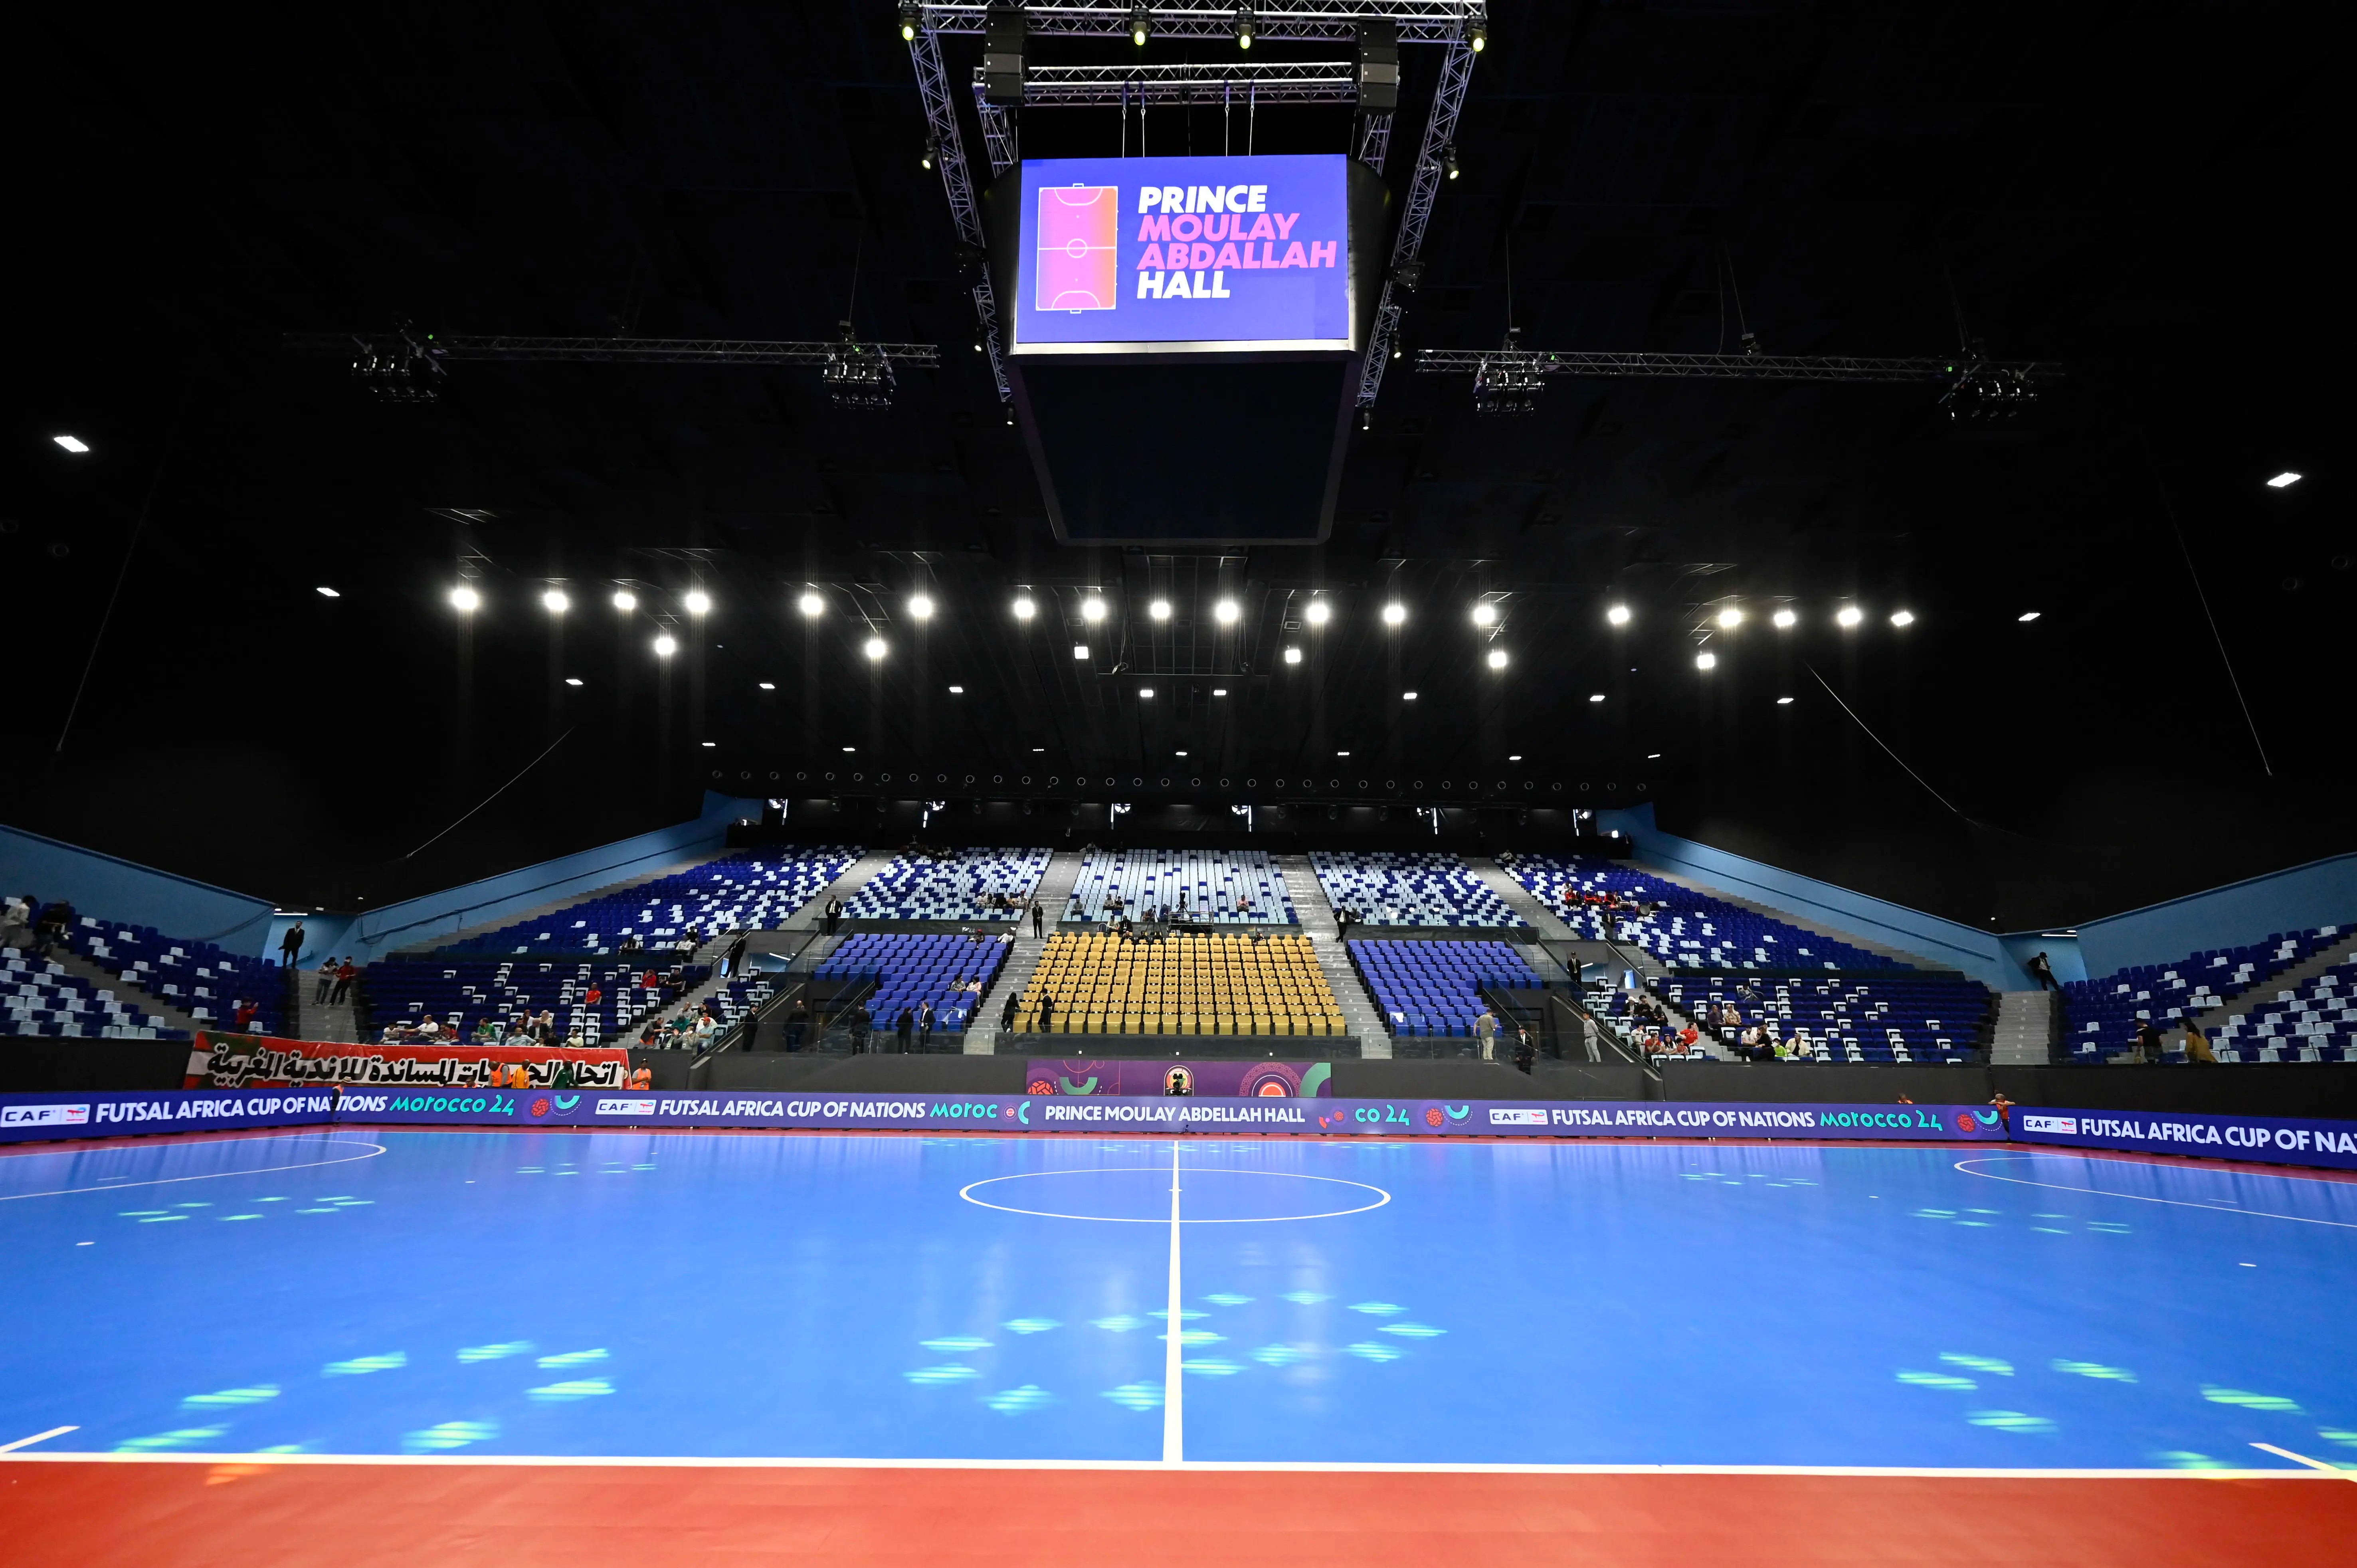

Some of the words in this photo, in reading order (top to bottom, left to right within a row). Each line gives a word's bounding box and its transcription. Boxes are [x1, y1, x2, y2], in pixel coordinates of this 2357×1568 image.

[1138, 185, 1268, 214] PRINCE
[1138, 213, 1300, 242] MOULAY
[1136, 240, 1337, 270] ABDALLAH
[1137, 270, 1231, 299] HALL
[570, 1062, 618, 1086] اتحا
[5, 1111, 51, 1122] CAF
[96, 1101, 173, 1123] FUTSAL
[176, 1099, 244, 1119] AFRICA
[247, 1097, 281, 1115] CUP
[283, 1097, 306, 1114] OF
[307, 1095, 388, 1112] NATIONS
[489, 1094, 515, 1116] 24
[659, 1099, 720, 1115] FUTSAL
[721, 1100, 784, 1117] AFRICA
[787, 1101, 821, 1117] CUP
[823, 1101, 849, 1117] OF
[849, 1102, 926, 1118] NATIONS
[1045, 1105, 1102, 1121] PRINCE
[1104, 1106, 1177, 1121] MOULAY
[1178, 1107, 1262, 1122] ABDELLAH
[1264, 1107, 1306, 1123] HALL
[1385, 1104, 1410, 1126] 24
[1552, 1109, 1613, 1125] FUTSAL
[1615, 1110, 1676, 1126] AFRICA
[1677, 1110, 1710, 1126] CUP
[1712, 1111, 1736, 1127] OF
[1738, 1111, 1815, 1127] NATIONS
[1916, 1110, 1943, 1131] 24
[2026, 1120, 2051, 1128] CAF
[2081, 1119, 2145, 1139] FUTSAL
[2148, 1122, 2222, 1145] AFRICA
[2225, 1127, 2270, 1147] CUP
[2275, 1129, 2310, 1150] OF
[2314, 1131, 2357, 1154] NA
